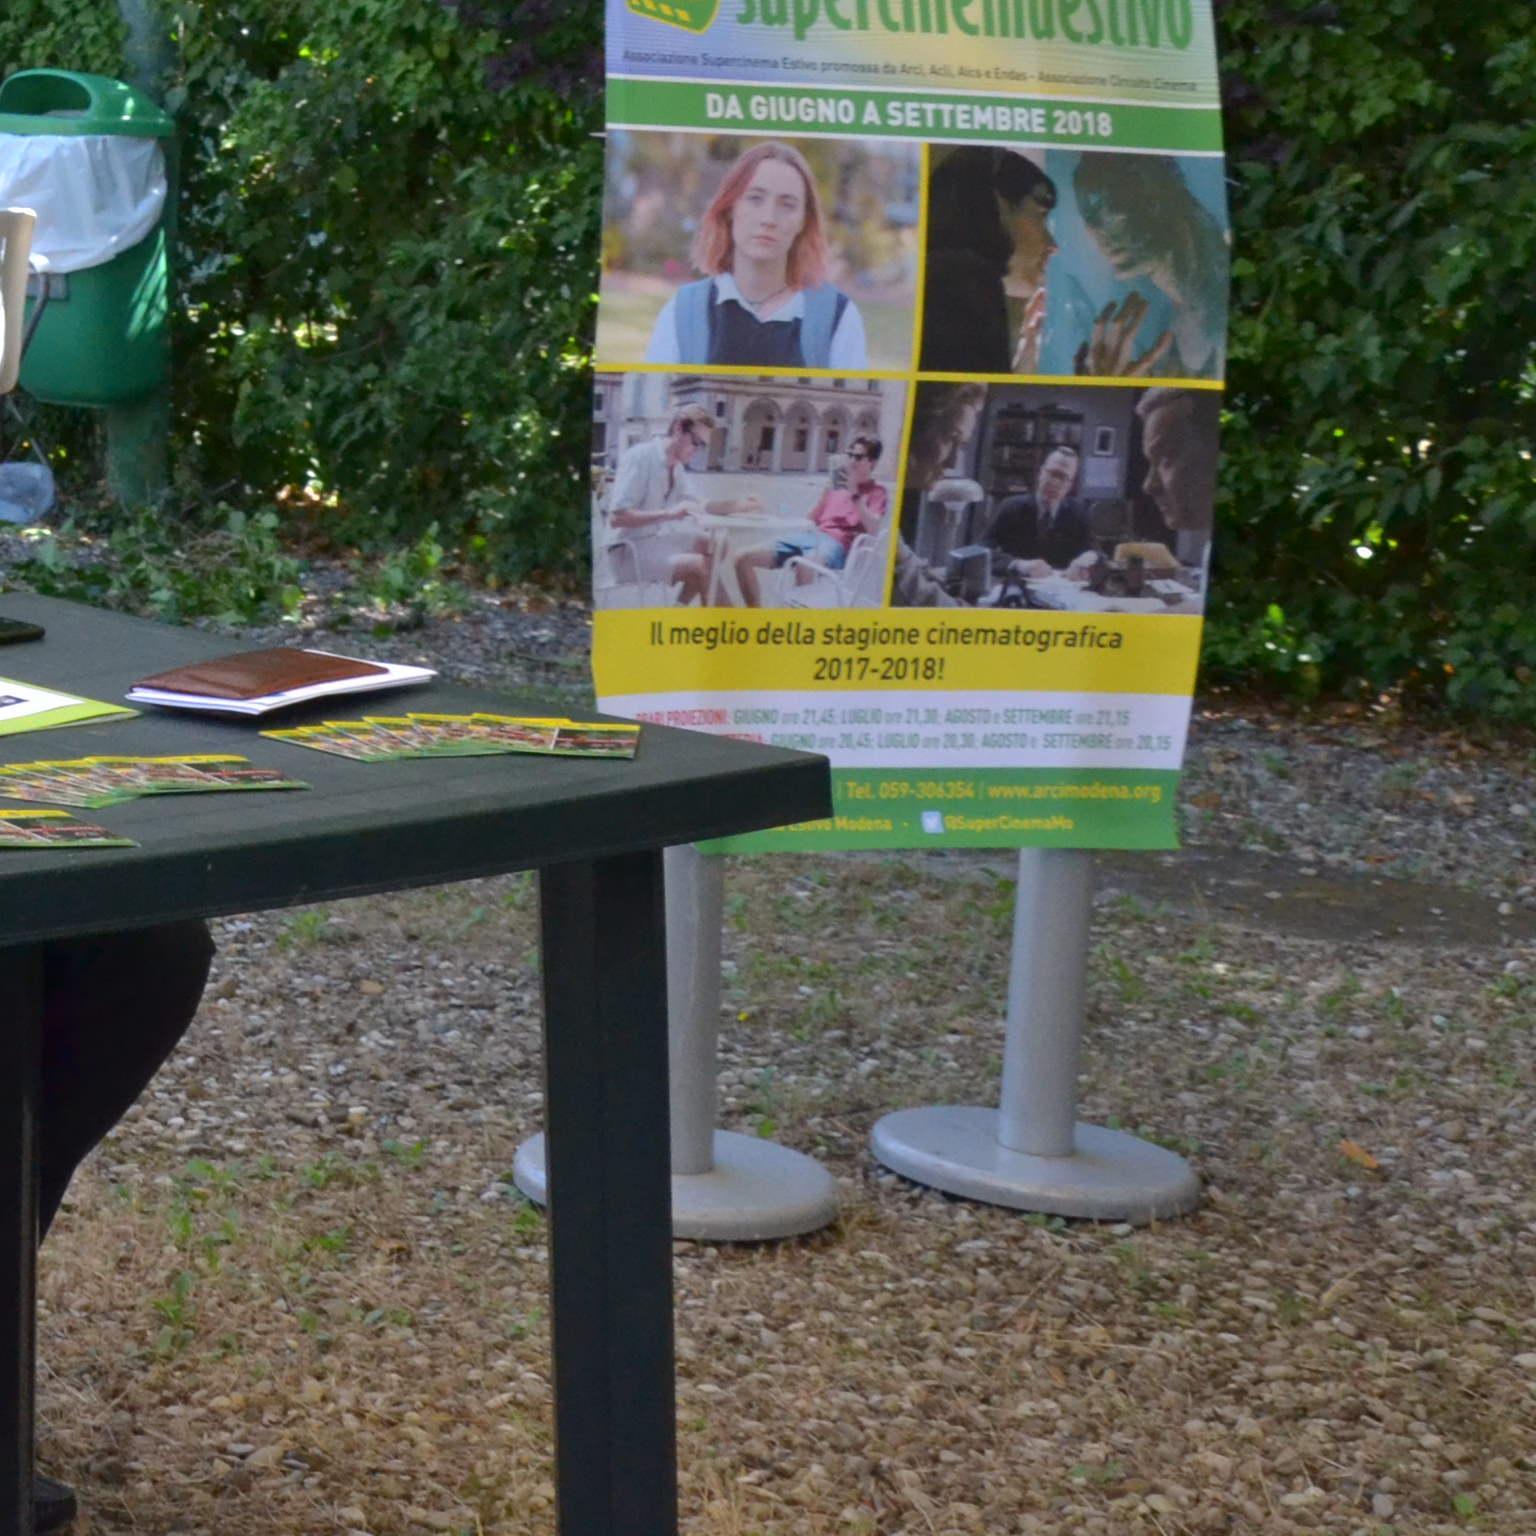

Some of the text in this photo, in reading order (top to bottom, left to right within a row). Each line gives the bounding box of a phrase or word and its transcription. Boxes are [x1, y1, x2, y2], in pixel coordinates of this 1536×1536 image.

[781, 57, 817, 71] Estivo
[820, 61, 880, 75] promossa
[882, 62, 897, 74] da
[705, 92, 1113, 138] DA GIUGNO A SETTEMBRE 2018
[650, 621, 1124, 653] Il meglio della stagione cinematografica
[813, 657, 946, 682] 2017-2018!
[733, 708, 778, 725] GIUGNO
[840, 708, 882, 725] LUGLIO
[944, 708, 992, 725] AGOSTO
[1003, 708, 1073, 725] SETTEMBRE
[877, 732, 921, 749] LUGLIO
[981, 732, 1027, 749] AGOSTO
[1042, 732, 1113, 750] SETTEMBRE
[847, 781, 875, 800] Tel.
[988, 782, 1162, 803] www.arcimodena.org
[835, 815, 892, 832] Modena
